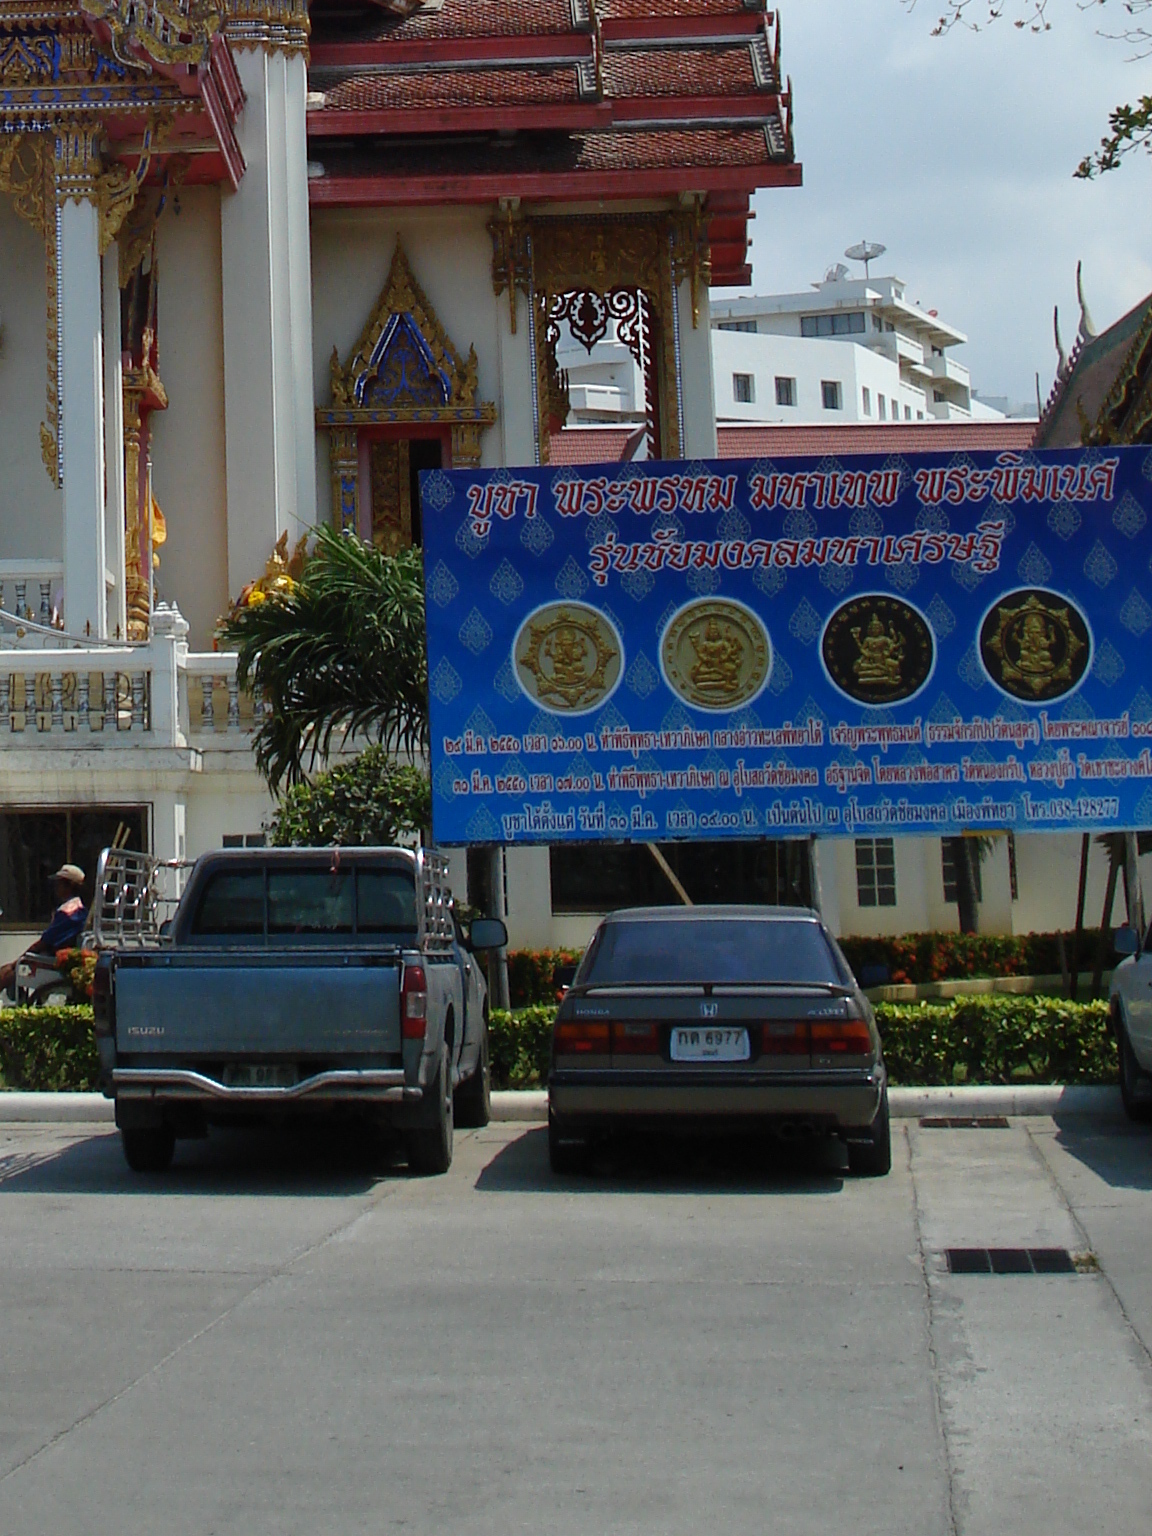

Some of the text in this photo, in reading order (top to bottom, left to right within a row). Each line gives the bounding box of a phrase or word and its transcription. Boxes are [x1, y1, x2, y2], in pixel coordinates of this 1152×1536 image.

[468, 482, 539, 537] บูชา
[554, 474, 737, 517] พระพรหม
[750, 468, 902, 511] มหาเทพ
[589, 520, 1006, 586] รุ่นชัยมงคลมหาเศรษฐี
[666, 810, 697, 828] เวลา
[127, 1026, 165, 1035] ISUZU
